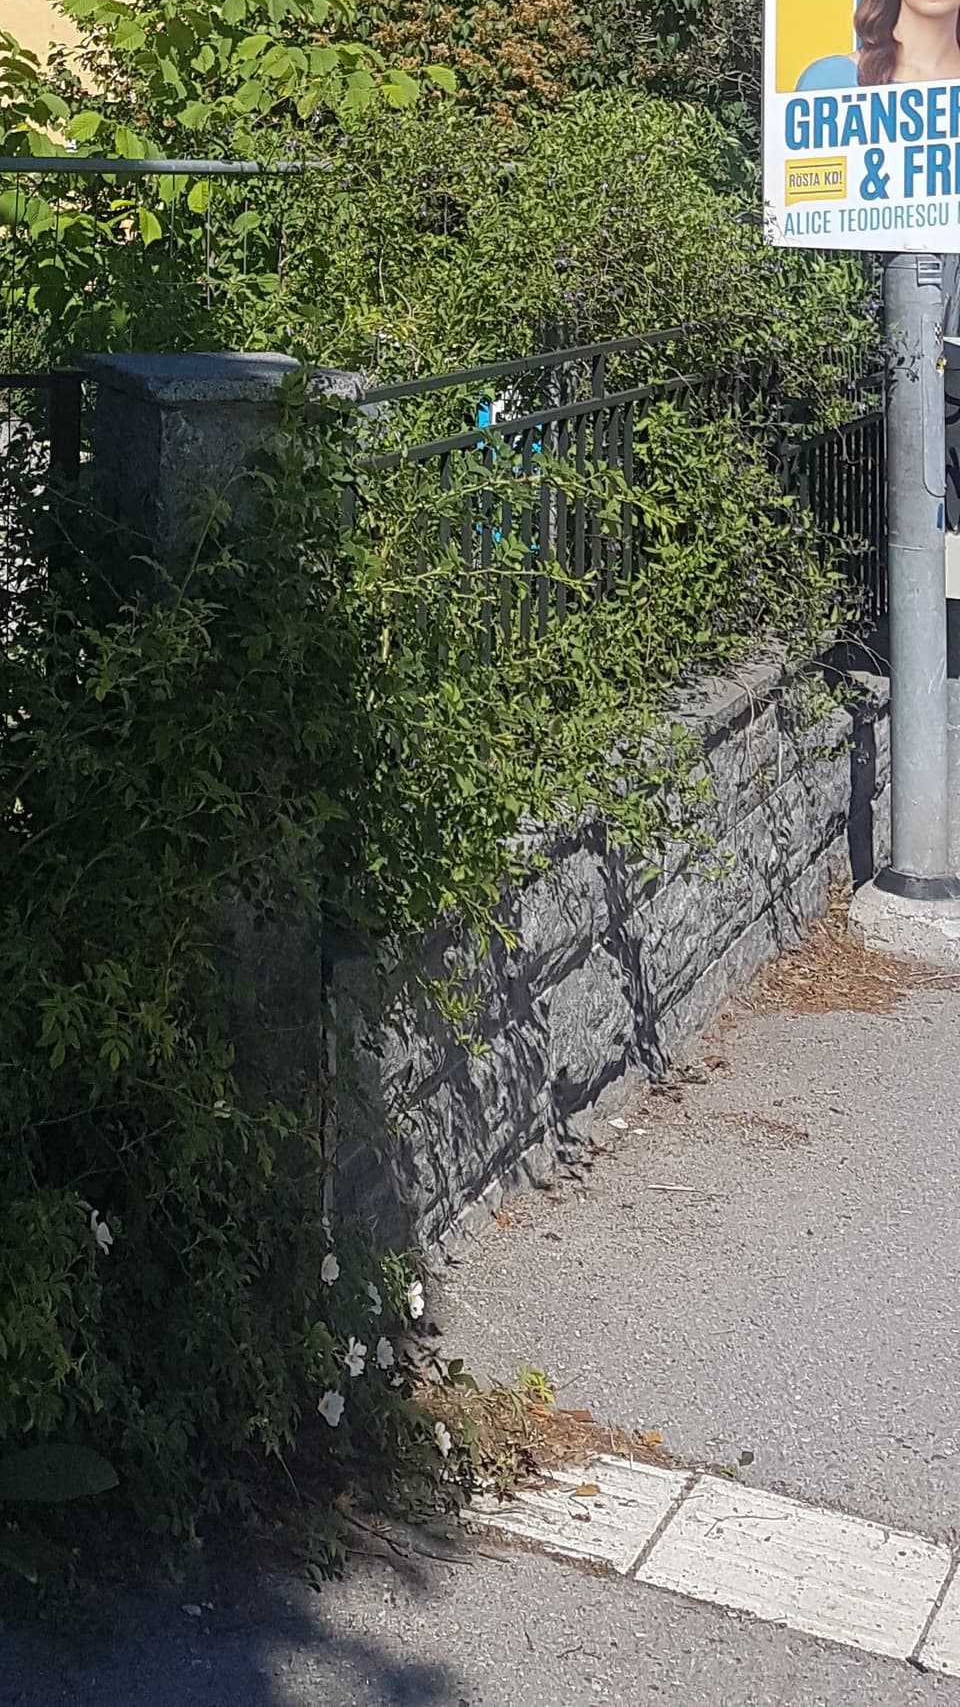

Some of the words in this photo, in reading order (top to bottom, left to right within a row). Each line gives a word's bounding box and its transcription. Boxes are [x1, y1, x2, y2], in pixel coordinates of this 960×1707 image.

[789, 171, 820, 188] RÖSTA
[824, 170, 843, 186] KD!
[859, 147, 891, 201] &
[784, 210, 832, 237] ALICE
[838, 201, 950, 233] TEODORESCU
